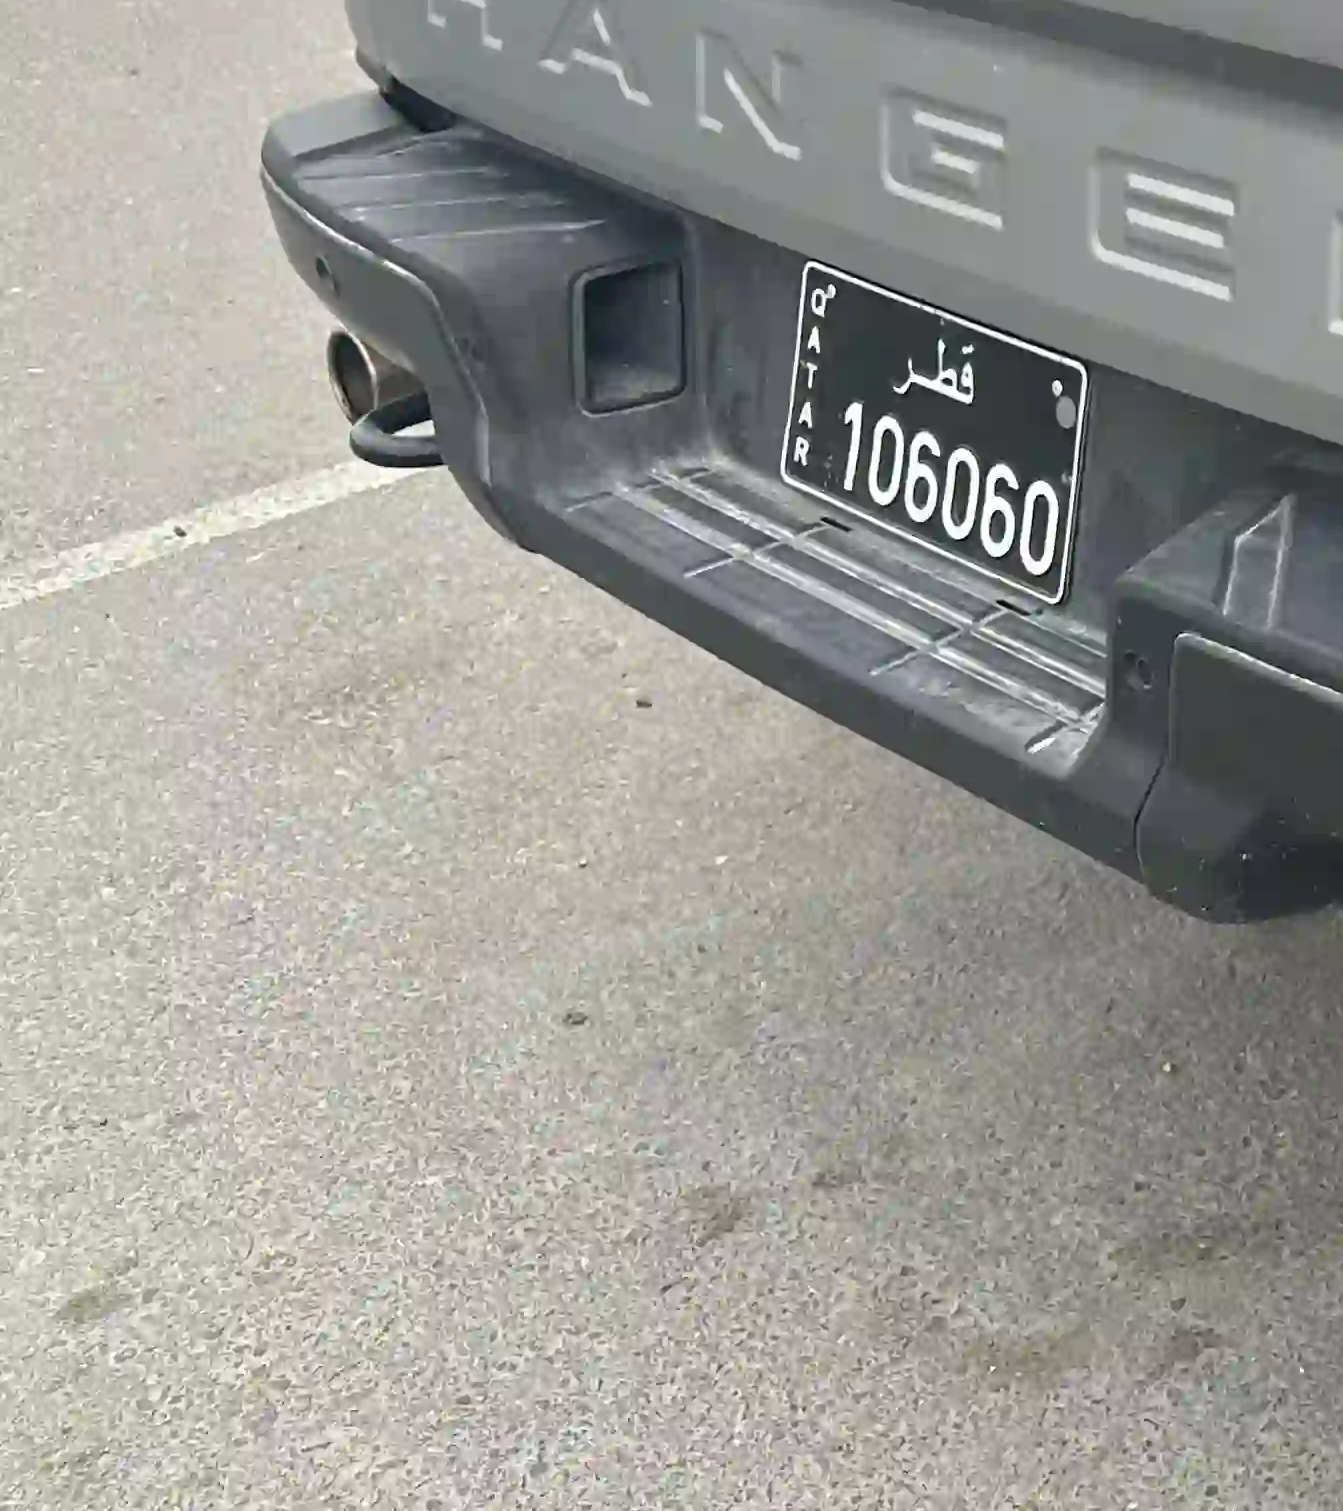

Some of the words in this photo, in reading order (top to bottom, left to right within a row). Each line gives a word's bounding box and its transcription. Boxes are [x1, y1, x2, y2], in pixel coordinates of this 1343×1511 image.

[793, 287, 827, 467] QATAR
[892, 338, 975, 405] قطر
[843, 401, 1061, 576] 106060
